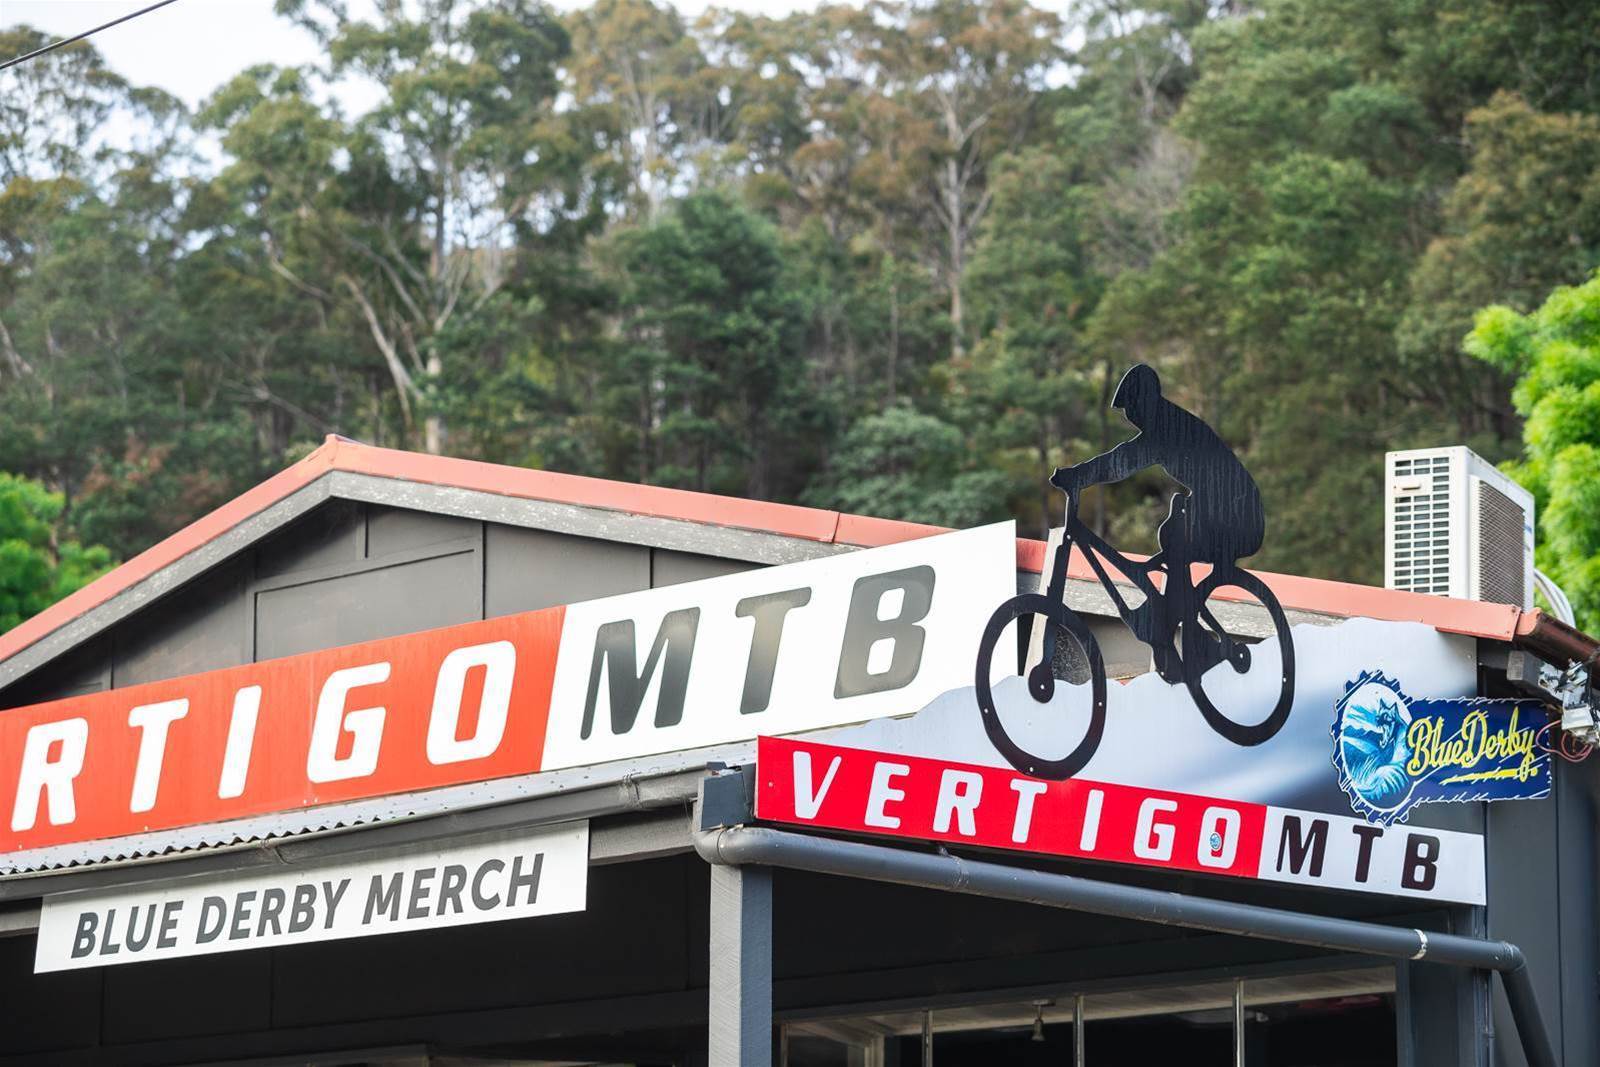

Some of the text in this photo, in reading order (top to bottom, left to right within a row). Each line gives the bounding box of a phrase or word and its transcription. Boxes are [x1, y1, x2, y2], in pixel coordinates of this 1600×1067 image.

[10, 564, 936, 832] RTIGO MTB
[793, 750, 1440, 891] VERTIGO MTB
[70, 853, 544, 959] BLUE DERBY MERCH
